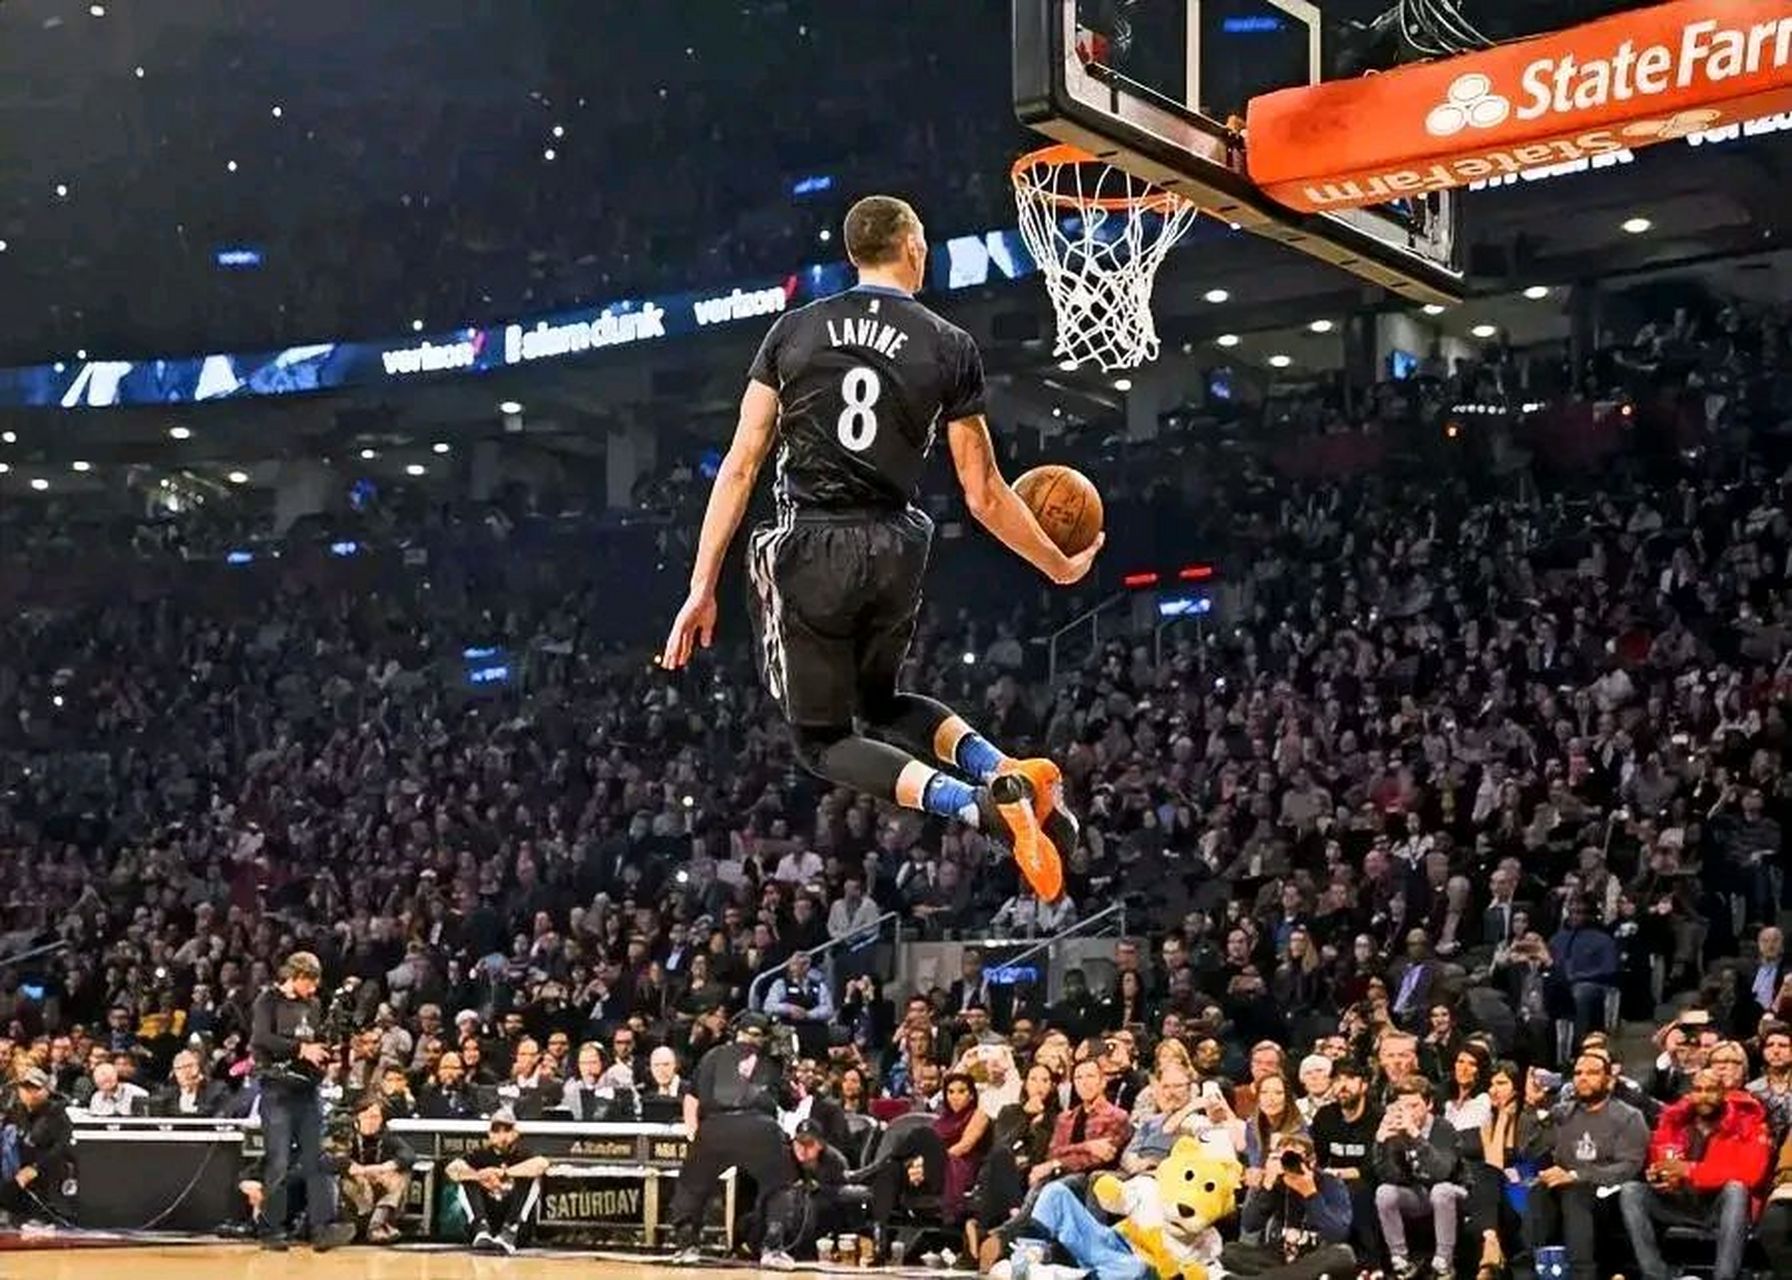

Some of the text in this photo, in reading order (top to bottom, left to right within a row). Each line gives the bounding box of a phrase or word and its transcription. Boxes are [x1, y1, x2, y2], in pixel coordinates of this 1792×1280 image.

[694, 286, 786, 326] verizon
[382, 340, 474, 375] verizon
[826, 318, 909, 359] LAVINE
[837, 366, 881, 452] 8
[545, 1188, 640, 1219] SATURDAY
